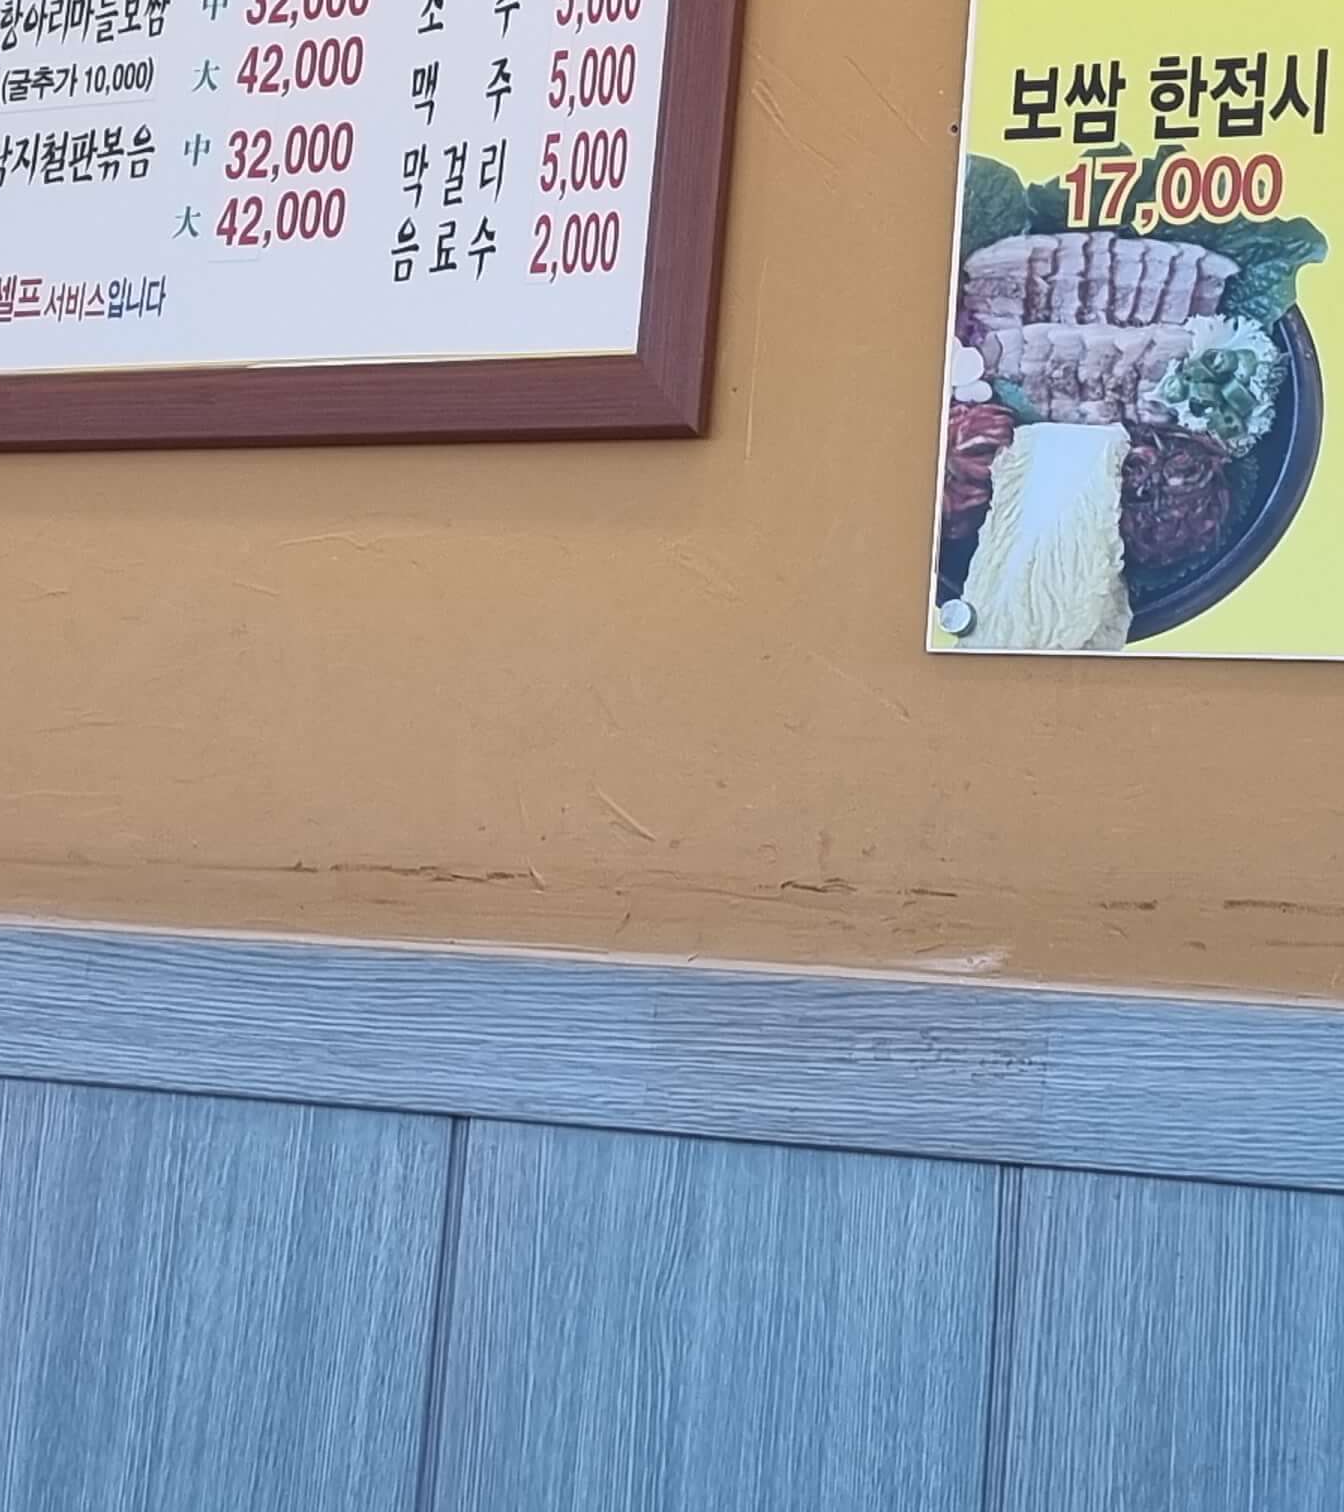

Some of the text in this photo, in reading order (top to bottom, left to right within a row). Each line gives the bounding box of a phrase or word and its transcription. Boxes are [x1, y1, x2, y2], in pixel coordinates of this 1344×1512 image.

[1, 56, 155, 105] (굴추가 10,000)
[192, 36, 364, 97] 大 42,000
[548, 44, 636, 117] 5,000
[1003, 48, 1329, 144] 보쌈 한접시
[184, 134, 211, 167] 中
[225, 122, 354, 182] 32,000
[403, 128, 627, 209] 막걸리 5,000
[172, 188, 346, 248] 大 42,000
[1065, 153, 1283, 229] 17,000
[390, 211, 619, 282] 음료수 2,000
